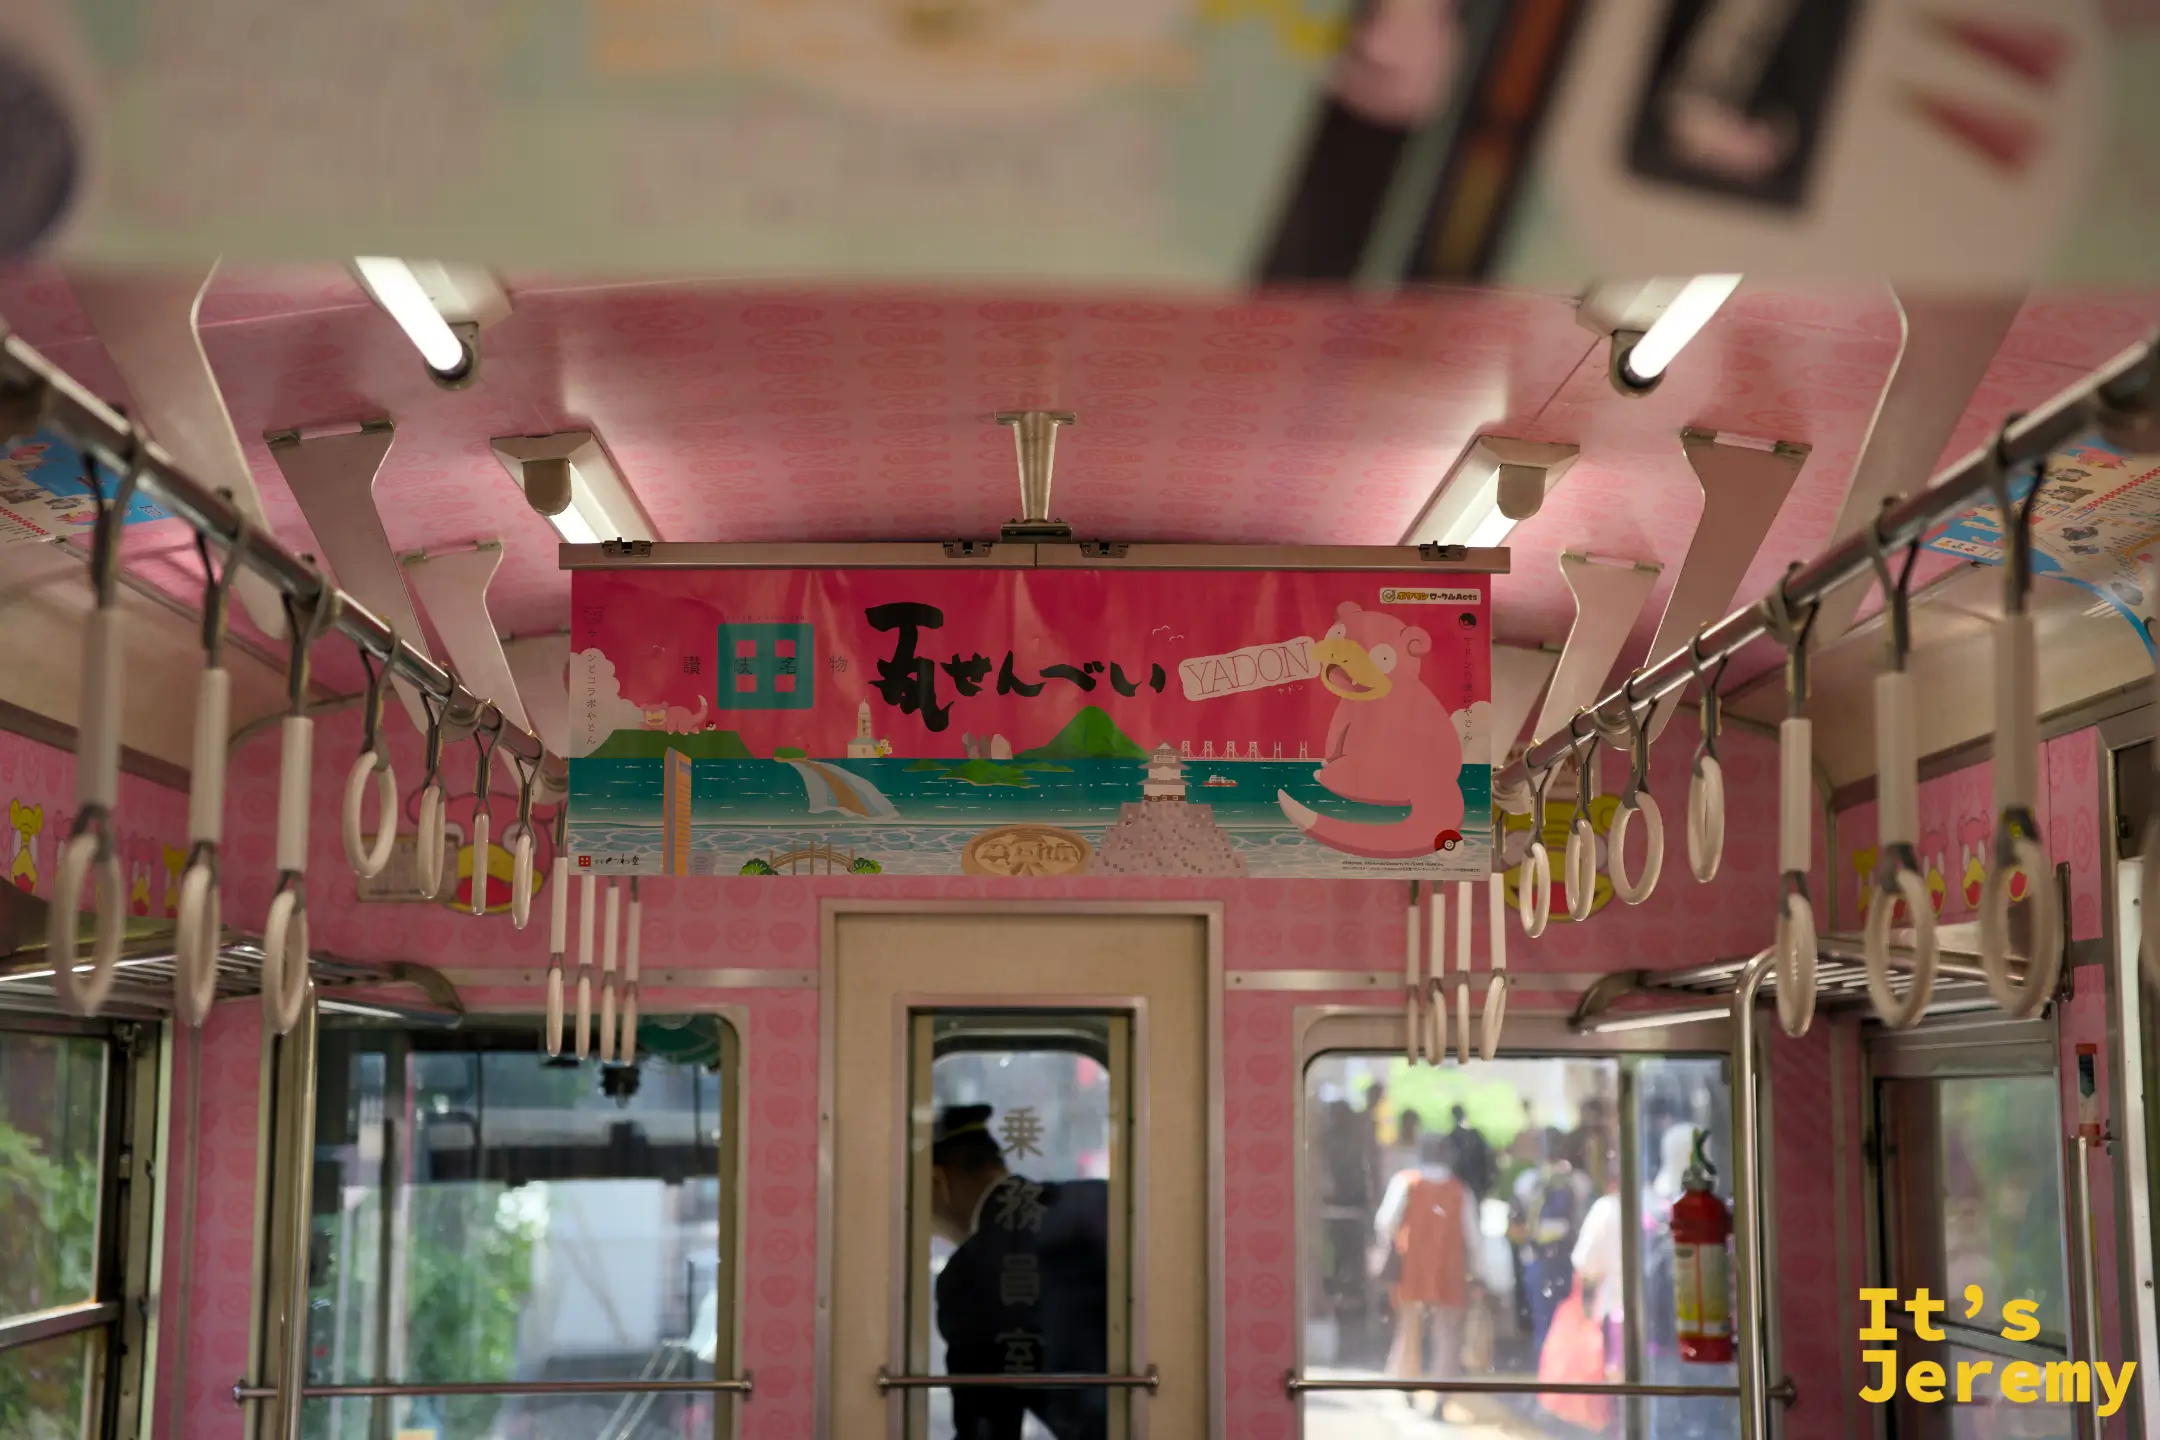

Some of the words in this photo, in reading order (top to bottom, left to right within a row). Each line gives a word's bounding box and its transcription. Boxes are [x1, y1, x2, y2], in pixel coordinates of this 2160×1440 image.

[683, 655, 848, 675] 讃岐名物
[865, 602, 1166, 732] 瓦せんべい
[1184, 641, 1309, 695] YADON
[995, 1106, 1047, 1374] 乗務員室
